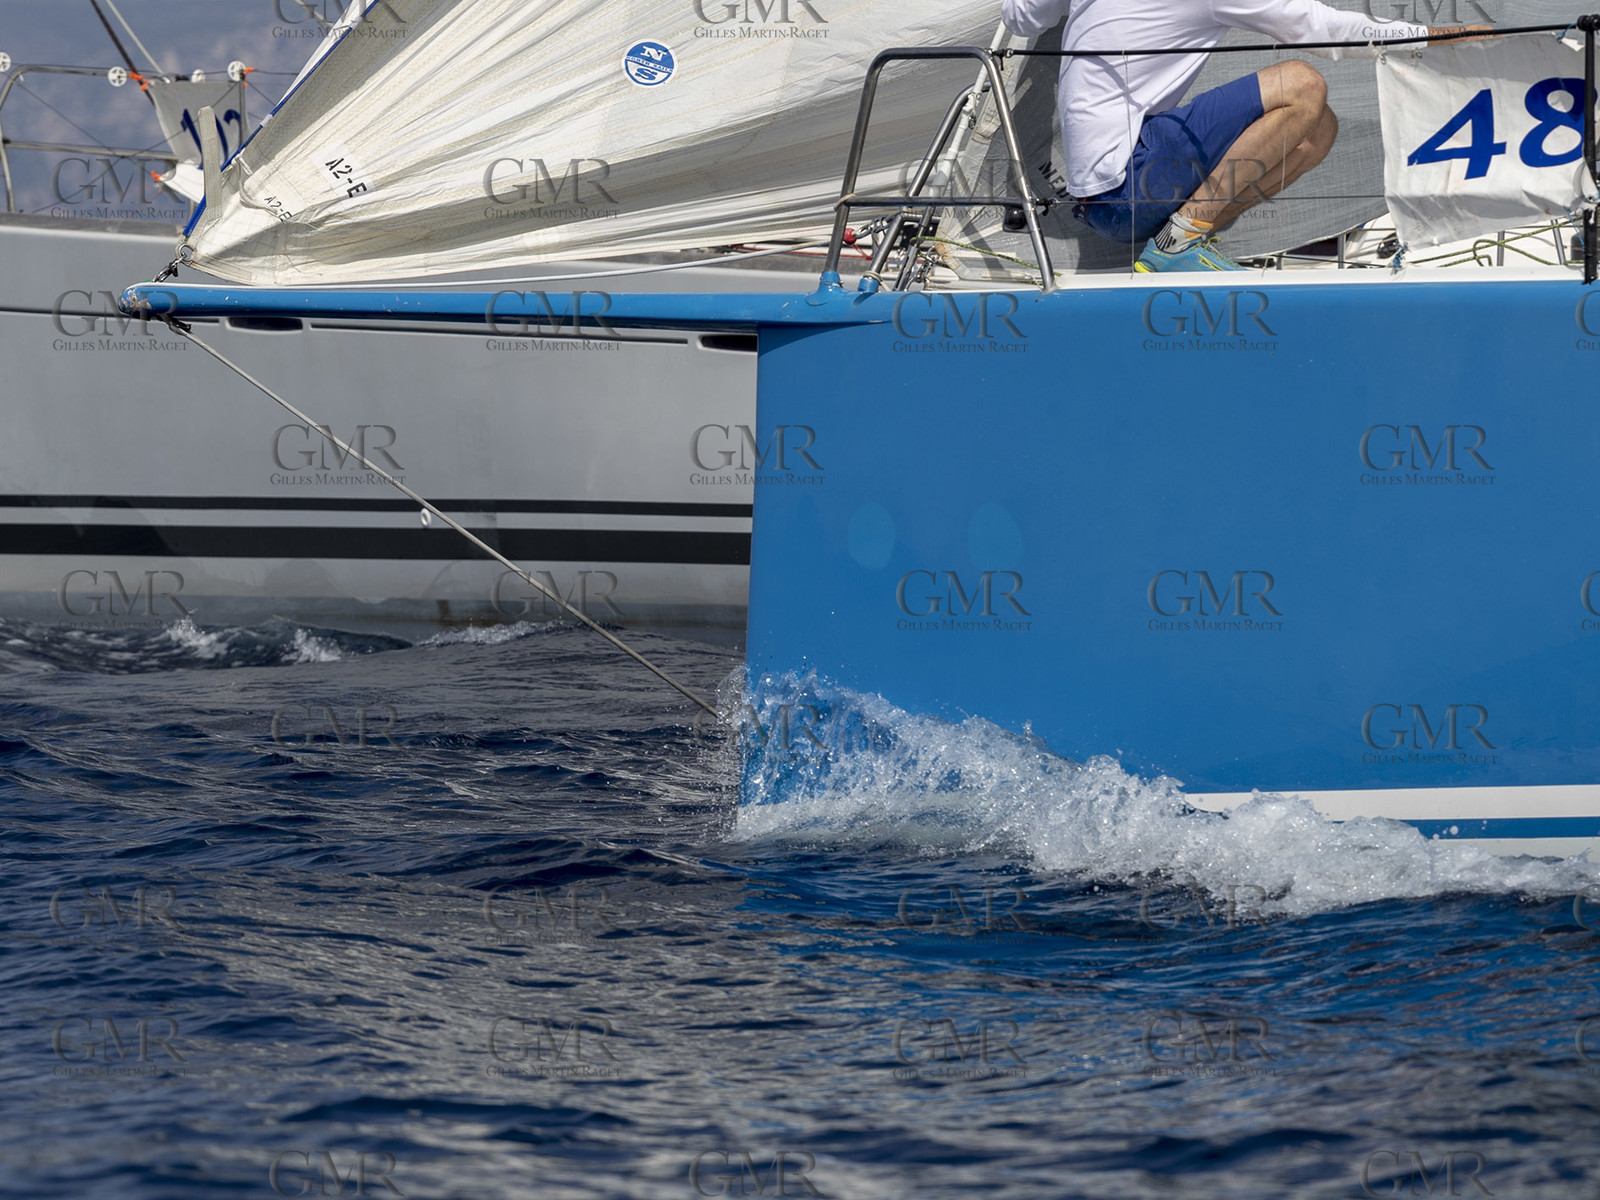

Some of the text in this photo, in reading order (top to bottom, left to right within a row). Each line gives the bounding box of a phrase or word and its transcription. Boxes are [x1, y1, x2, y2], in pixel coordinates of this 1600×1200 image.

[640, 46, 667, 61] N
[635, 68, 658, 81] S
[1408, 77, 1598, 180] 48
[325, 158, 368, 198] A2-E
